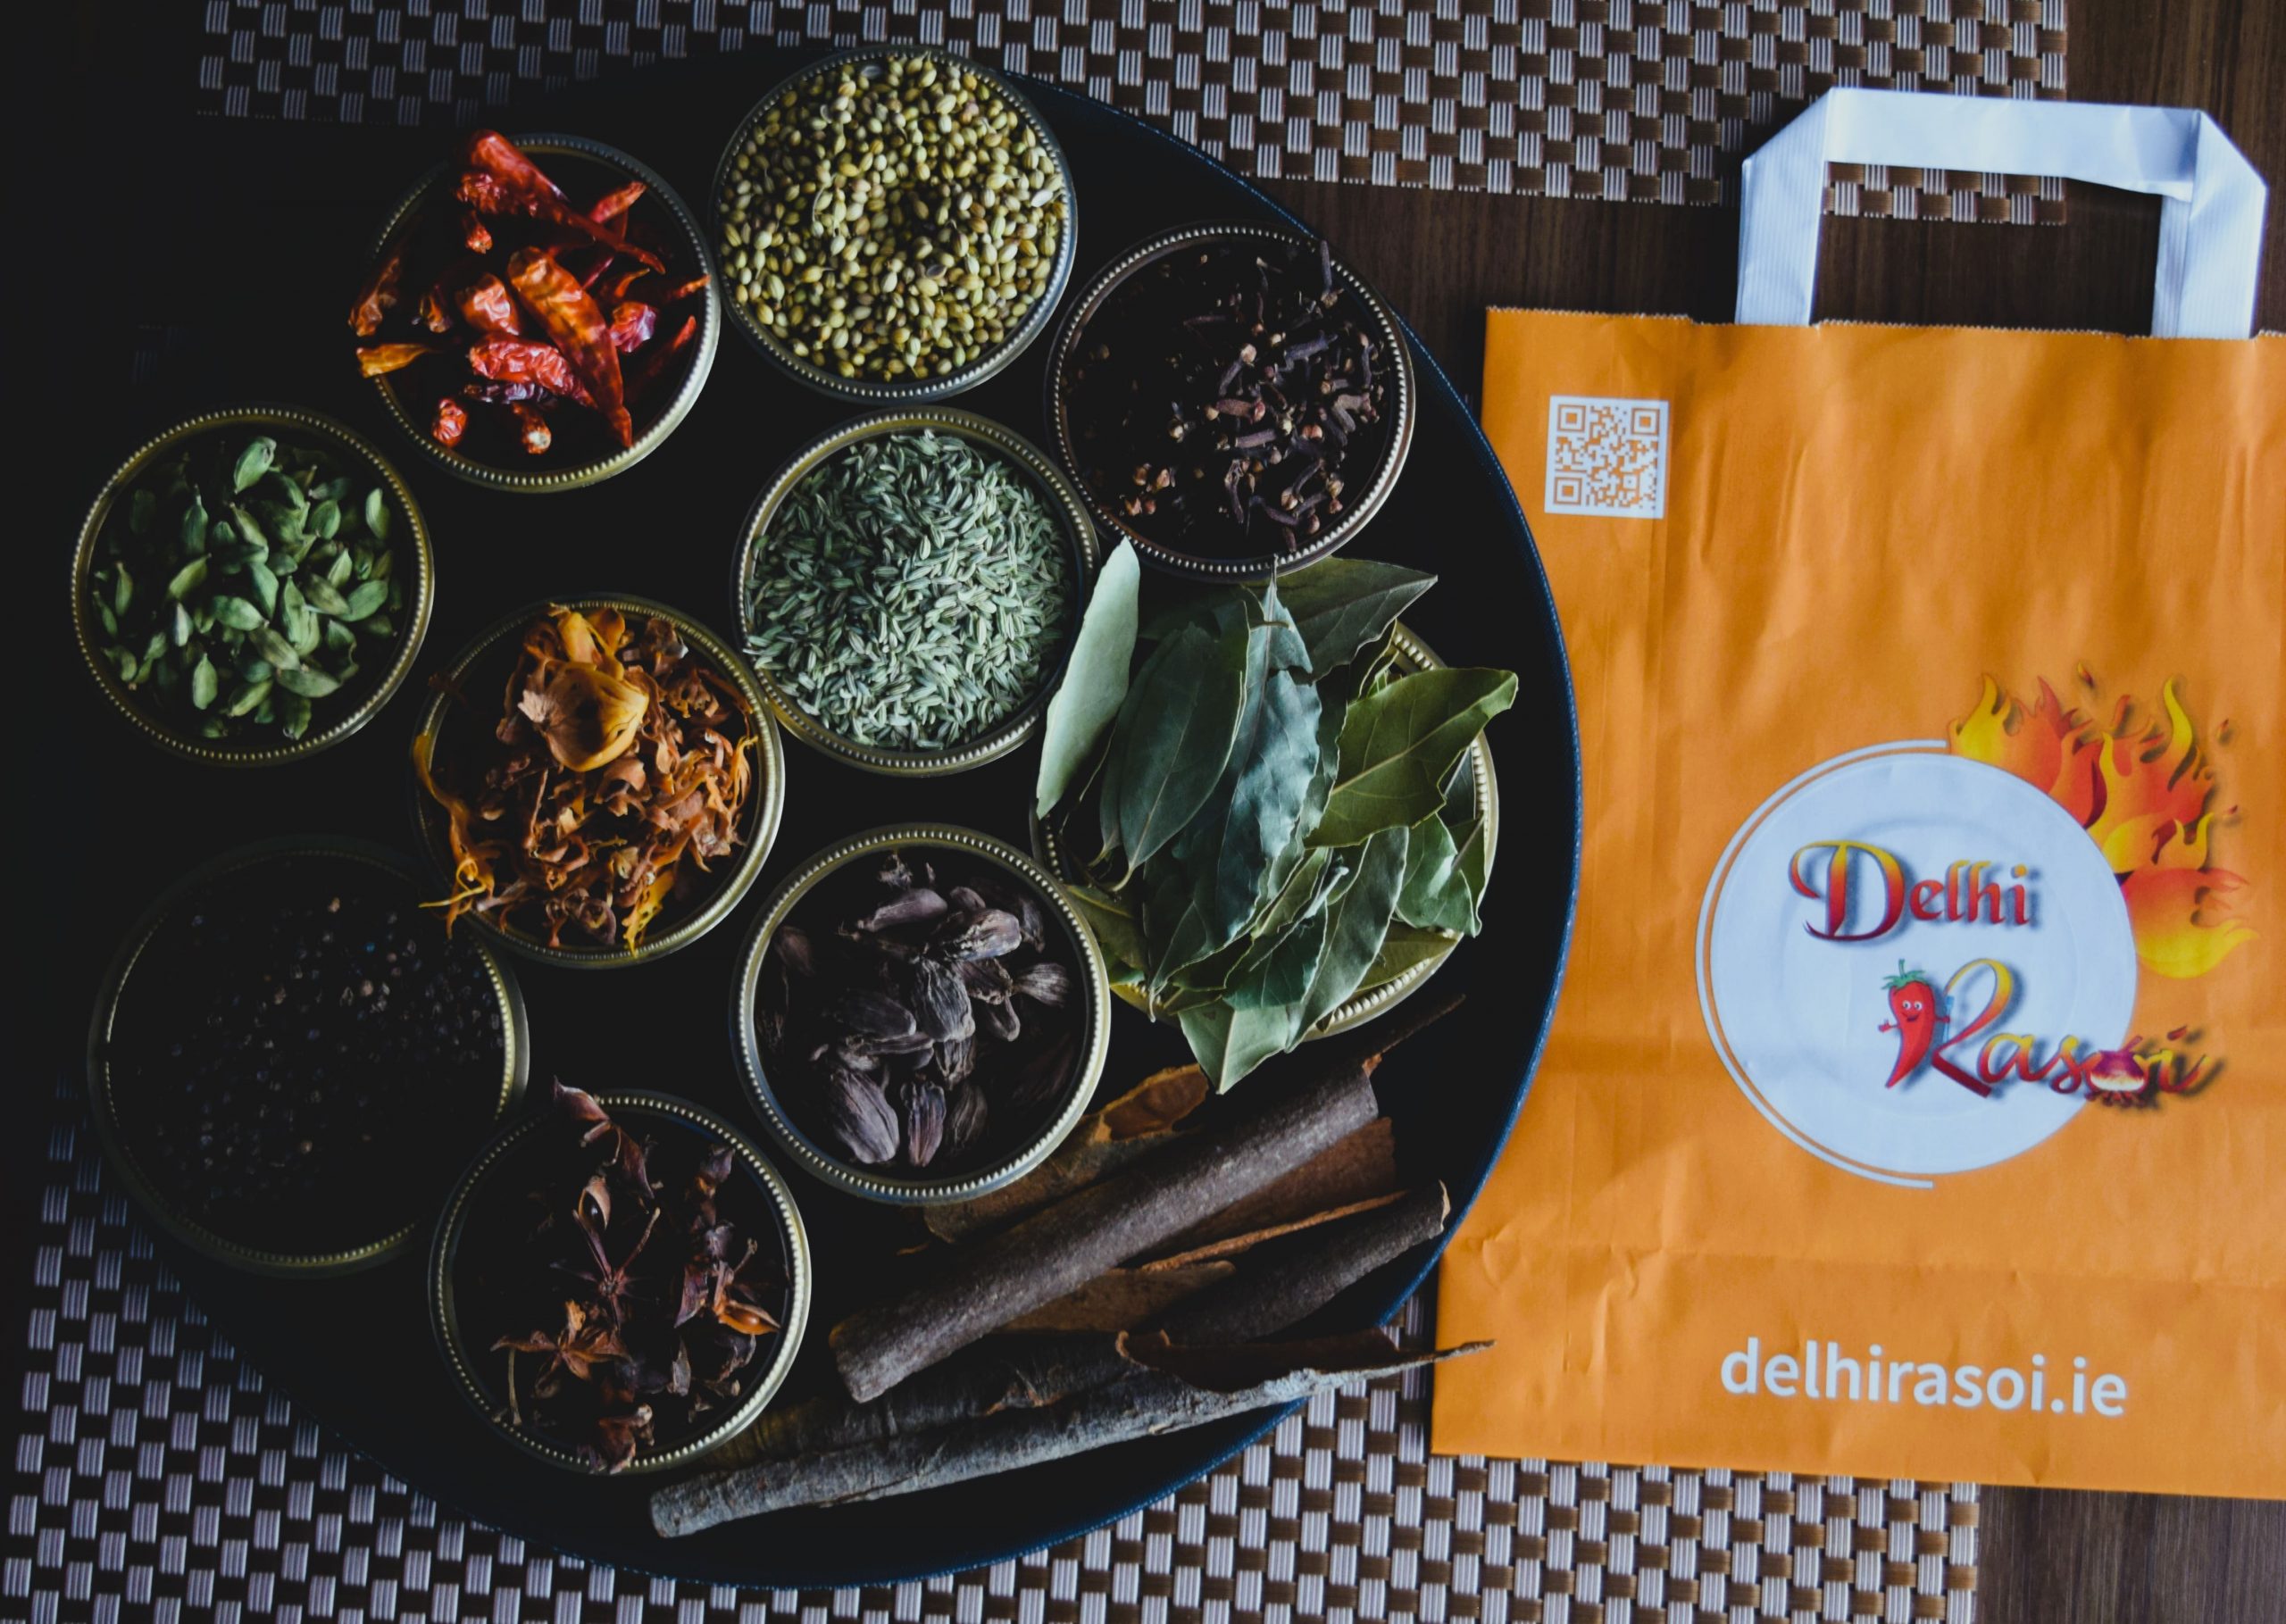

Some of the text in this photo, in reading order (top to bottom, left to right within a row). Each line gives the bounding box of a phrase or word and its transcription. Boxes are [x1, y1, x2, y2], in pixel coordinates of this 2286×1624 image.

[1789, 840, 2031, 942] Delhi
[1880, 959, 2213, 1103] Rasoi
[1720, 1337, 2127, 1416] delhirasoi.ie
